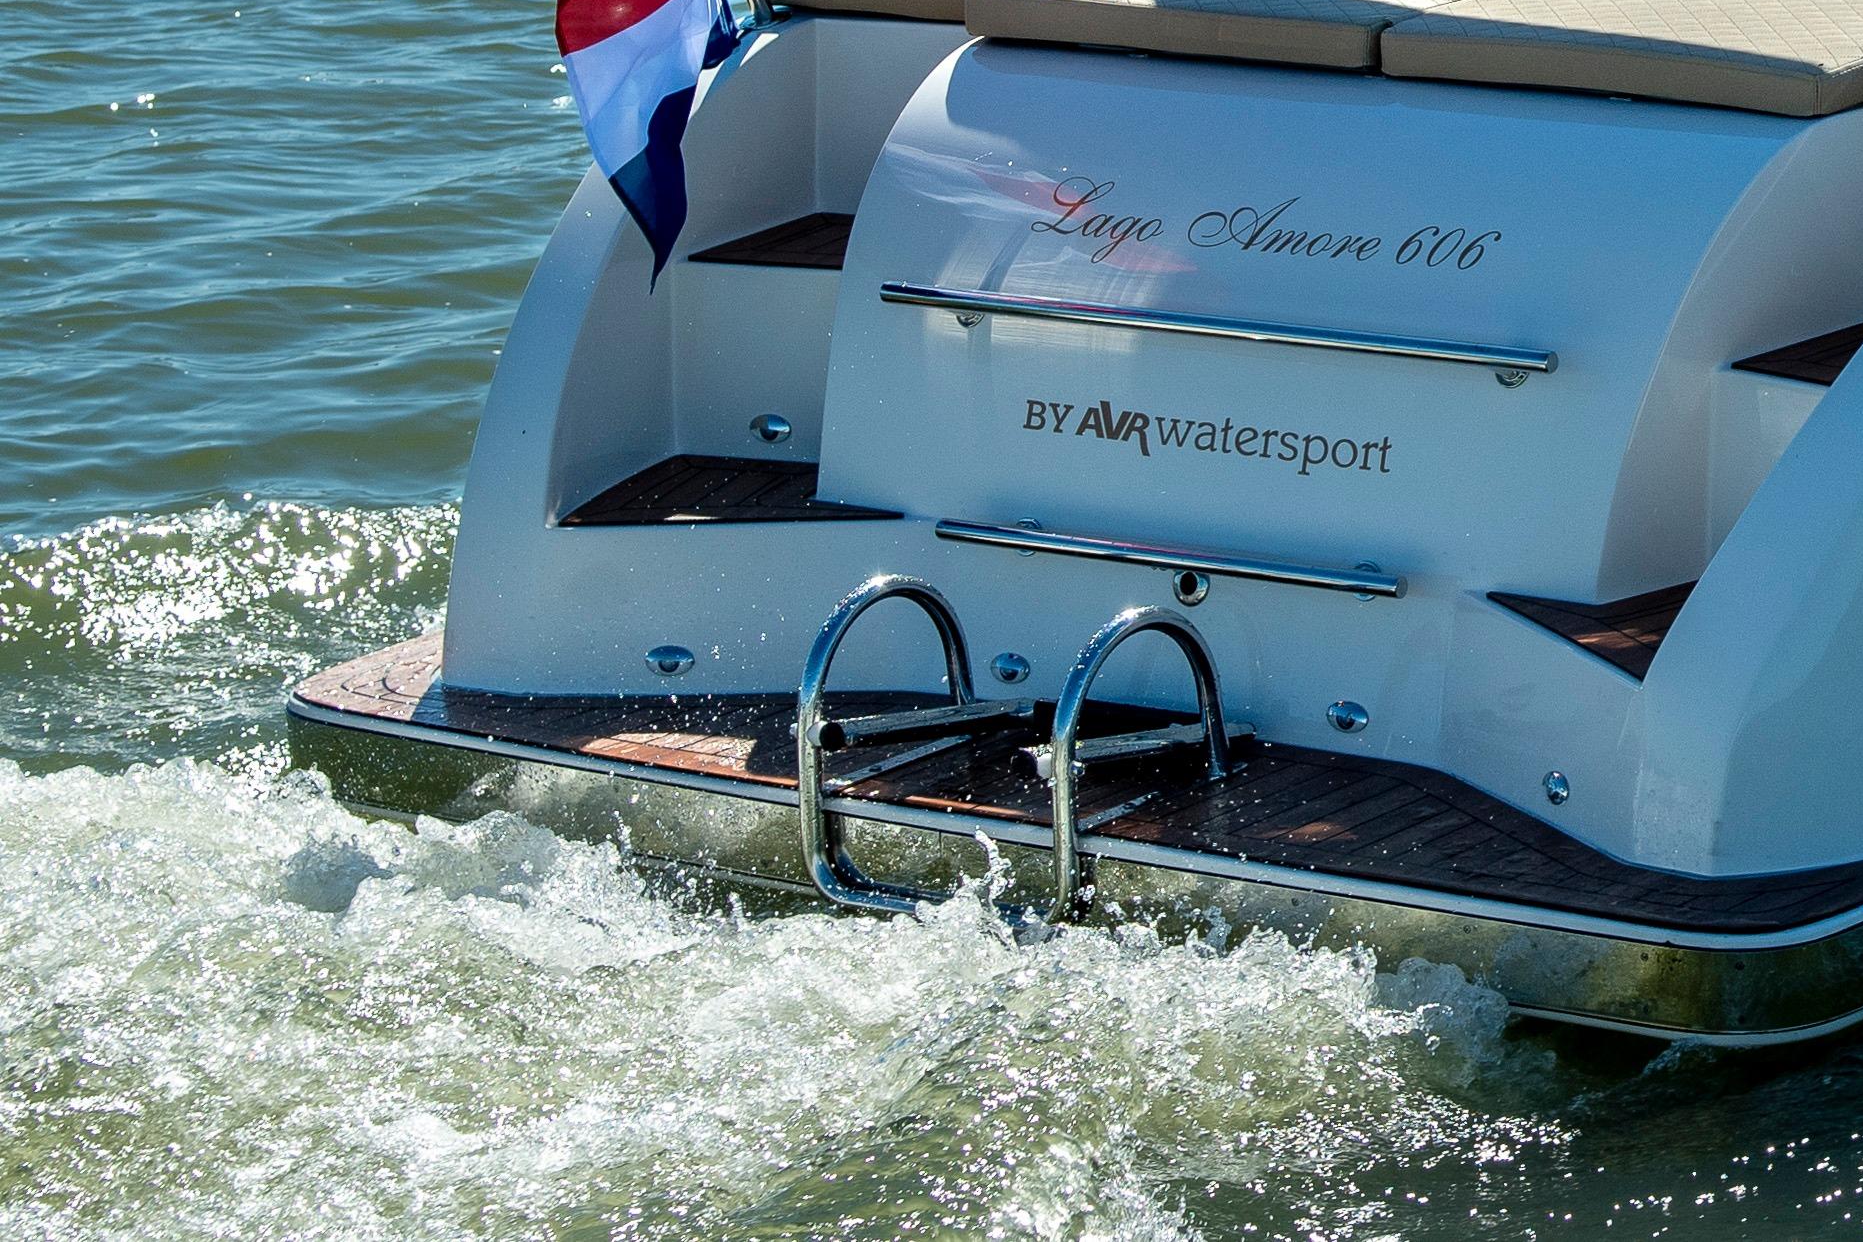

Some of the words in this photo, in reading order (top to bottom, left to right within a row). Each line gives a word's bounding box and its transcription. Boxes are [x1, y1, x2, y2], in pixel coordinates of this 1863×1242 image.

[1031, 176, 1164, 264] Lago
[1187, 195, 1382, 262] Amore
[1395, 225, 1503, 271] 606
[1023, 399, 1075, 433] BY
[1075, 399, 1151, 457] AVR
[1155, 414, 1393, 476] watersport
